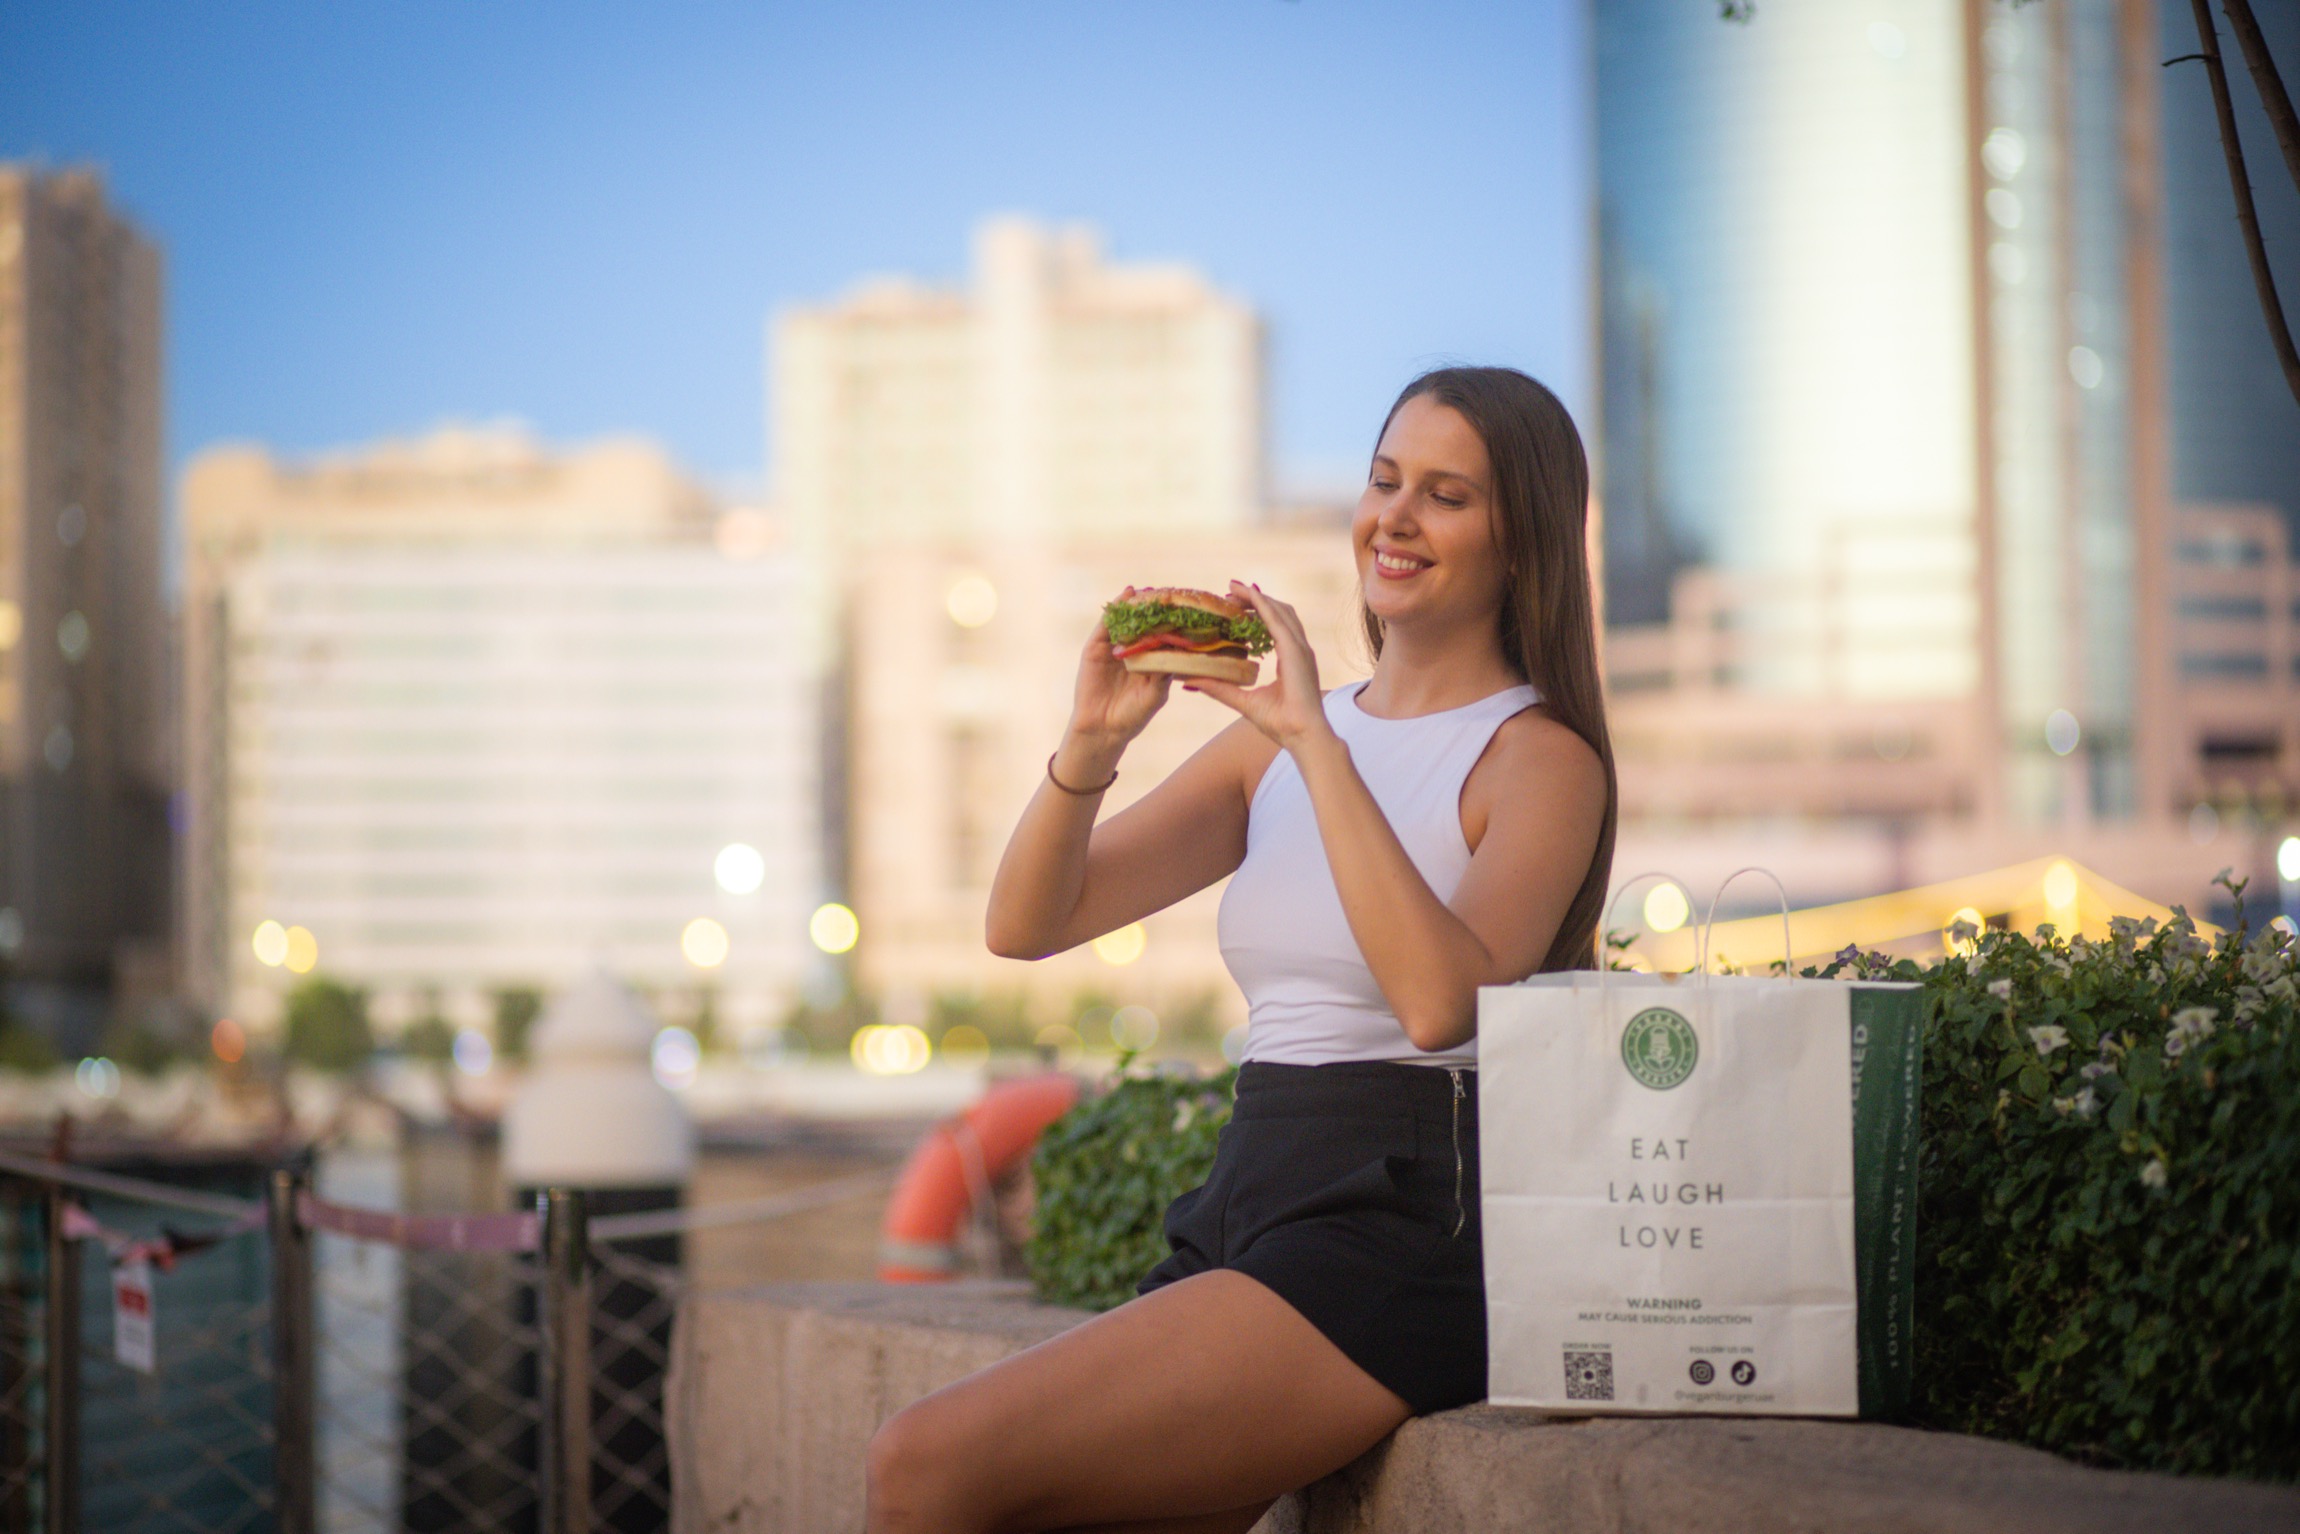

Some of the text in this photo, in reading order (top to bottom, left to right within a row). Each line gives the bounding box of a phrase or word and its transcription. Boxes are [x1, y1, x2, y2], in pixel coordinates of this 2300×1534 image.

[1631, 1138, 1689, 1160] EAT
[1608, 1181, 1723, 1204] LAUGH
[1620, 1226, 1703, 1248] LOVE
[1888, 1184, 1904, 1281] PLANT
[1627, 1297, 1702, 1310] WARNING
[1578, 1311, 1753, 1325] MAY CAUSE SERIOUS ADDICTION
